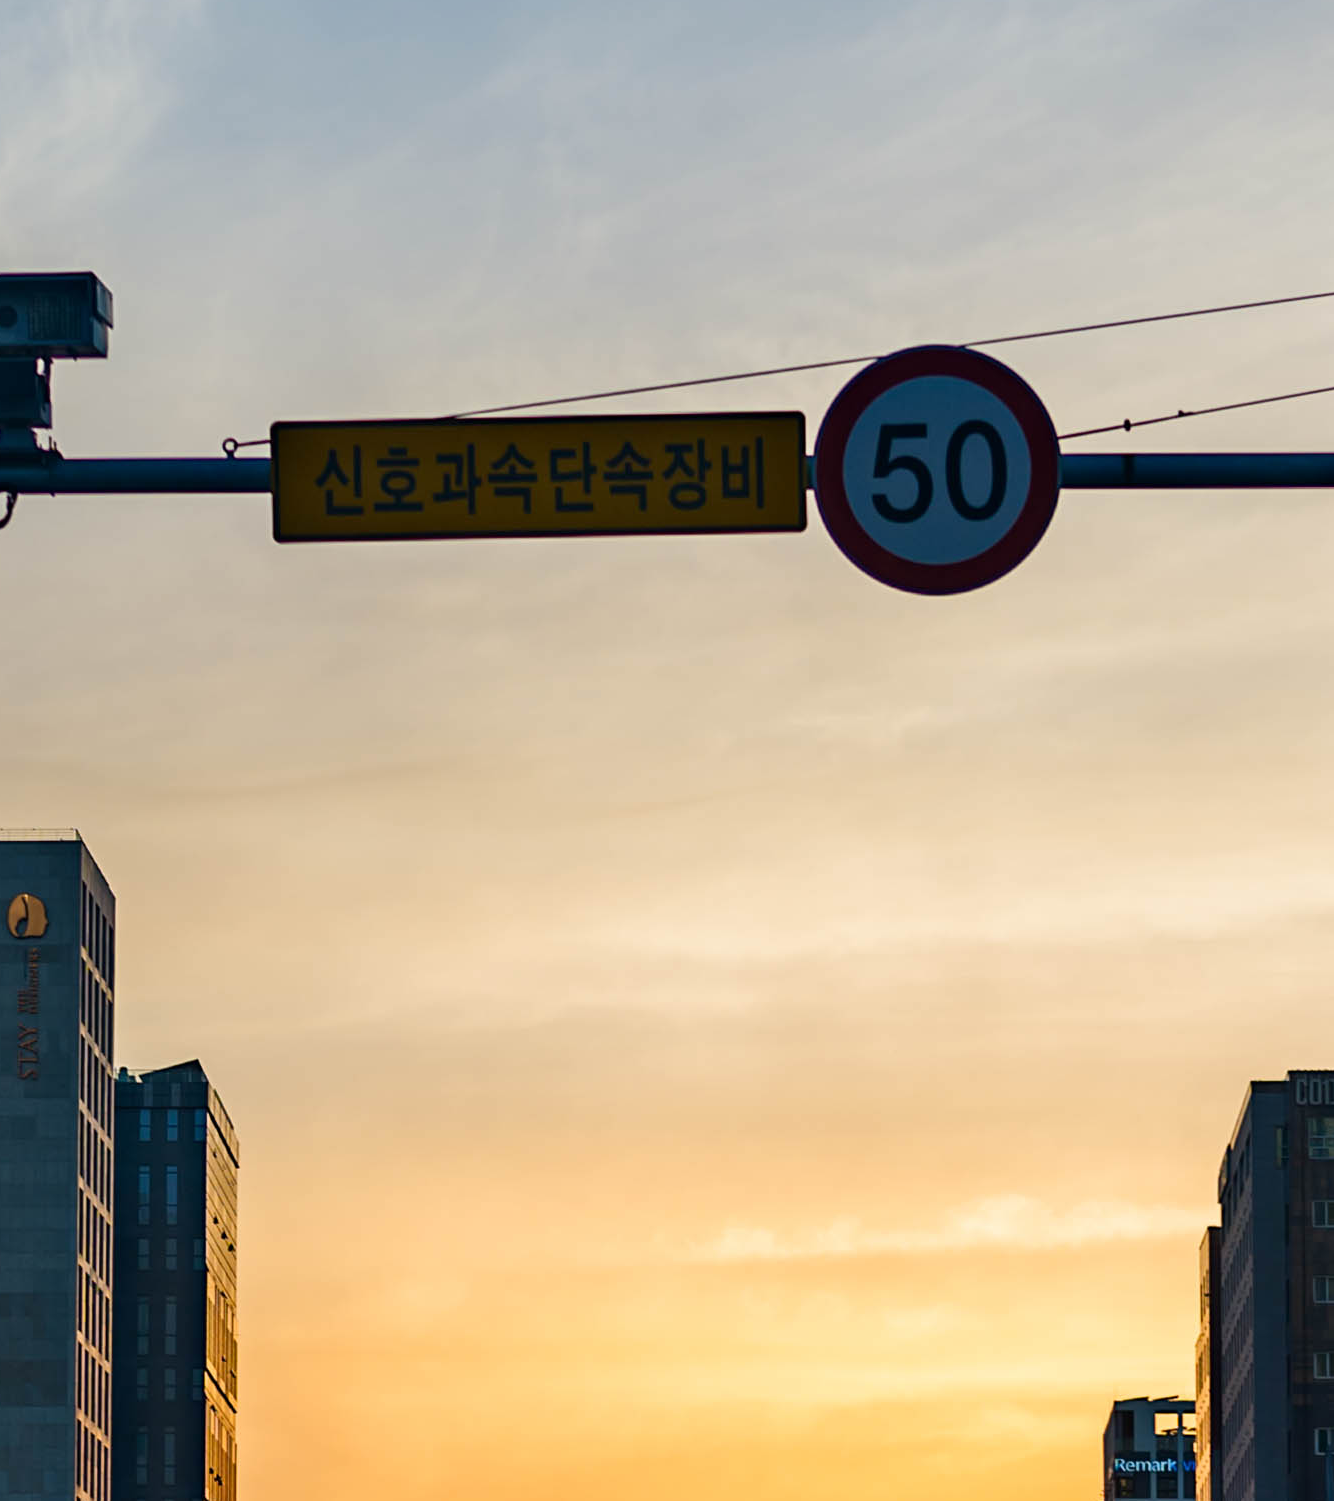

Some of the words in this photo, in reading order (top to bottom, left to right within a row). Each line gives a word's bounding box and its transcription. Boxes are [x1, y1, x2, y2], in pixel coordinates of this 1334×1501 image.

[314, 436, 769, 519] 신호과속단속장비
[870, 420, 1009, 525] 50
[17, 1024, 40, 1081] STAY
